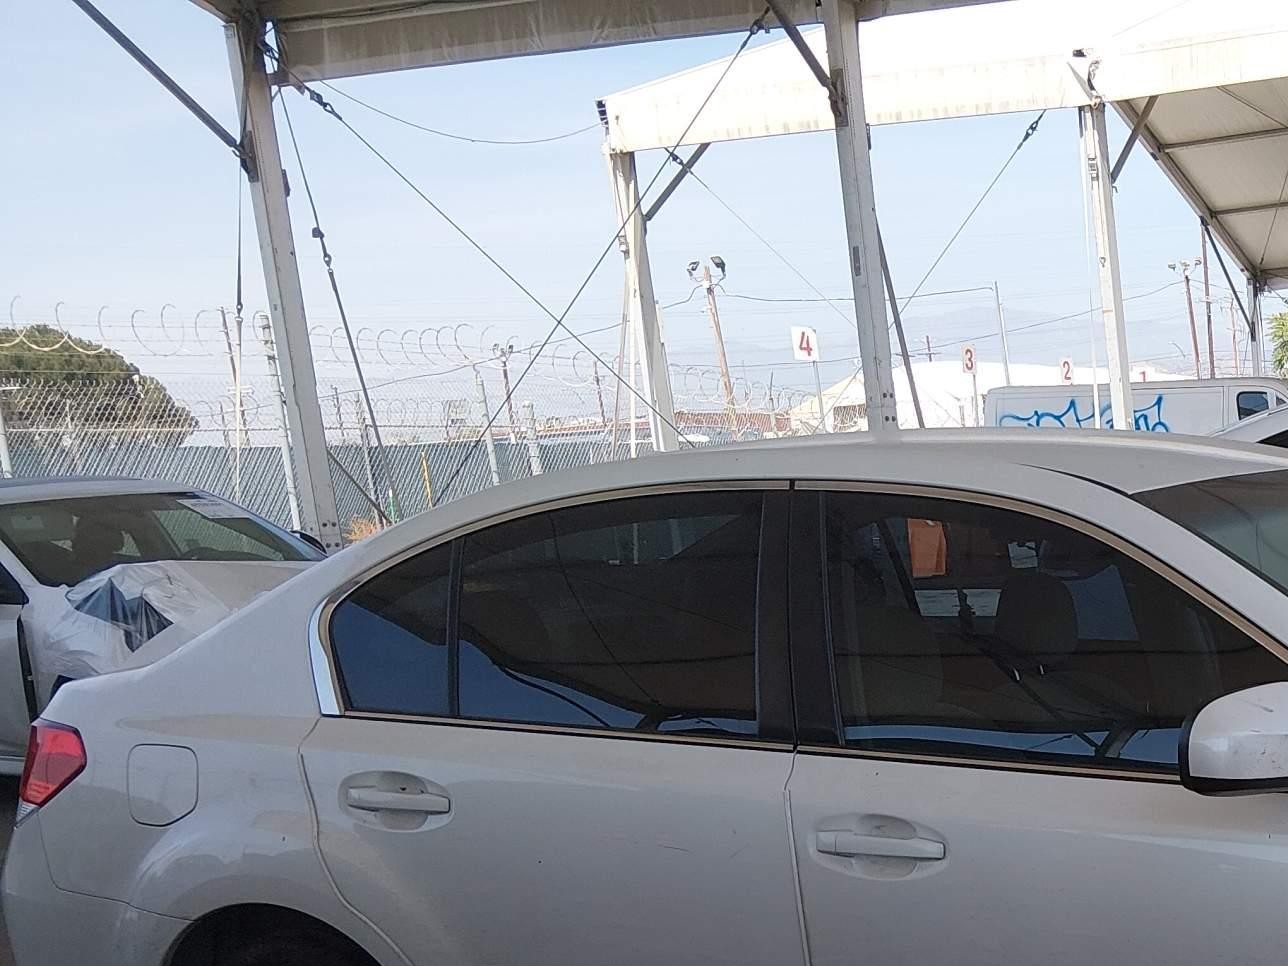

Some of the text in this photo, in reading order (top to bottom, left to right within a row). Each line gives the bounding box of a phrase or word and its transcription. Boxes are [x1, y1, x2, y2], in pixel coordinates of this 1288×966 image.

[799, 331, 813, 357] 4
[965, 348, 974, 371] 3
[1062, 360, 1072, 381] 2
